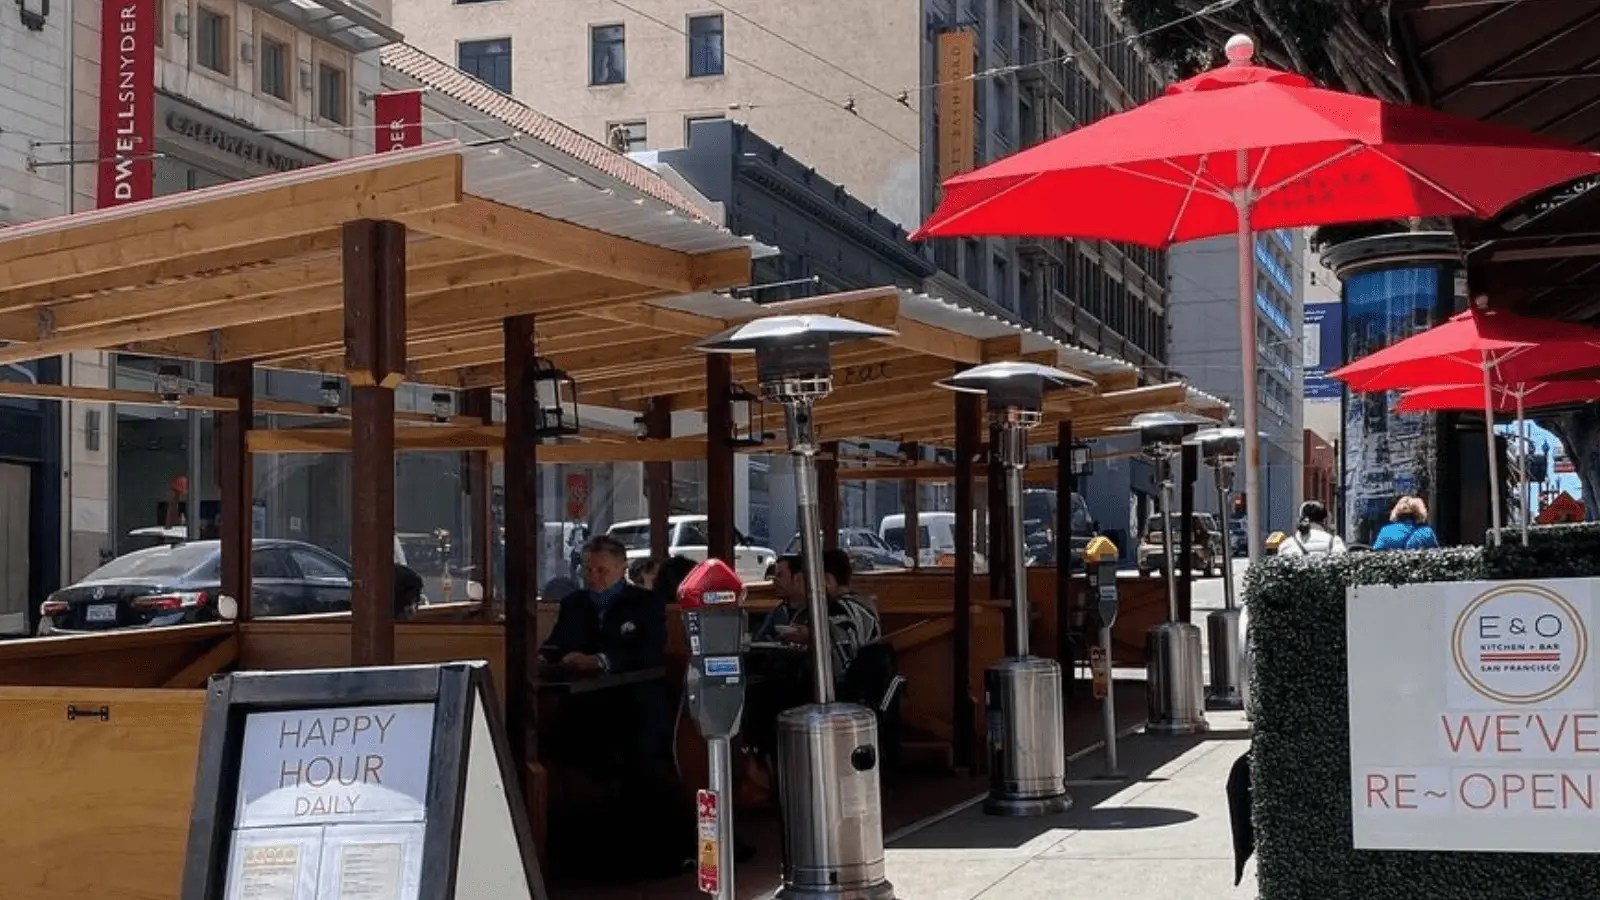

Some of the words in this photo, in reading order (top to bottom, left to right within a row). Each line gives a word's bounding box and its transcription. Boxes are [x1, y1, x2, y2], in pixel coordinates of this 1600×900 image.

[1479, 615, 1501, 638] E
[1509, 617, 1527, 635] &
[1535, 614, 1562, 637] O
[1480, 643, 1525, 651] KITCHEN
[1539, 643, 1559, 651] BAR
[1504, 664, 1560, 672] FRANCISCO
[279, 713, 396, 749] HAPPY
[1441, 714, 1599, 752] WE'VE
[279, 754, 384, 789] HOUR
[294, 795, 361, 817] DAILY
